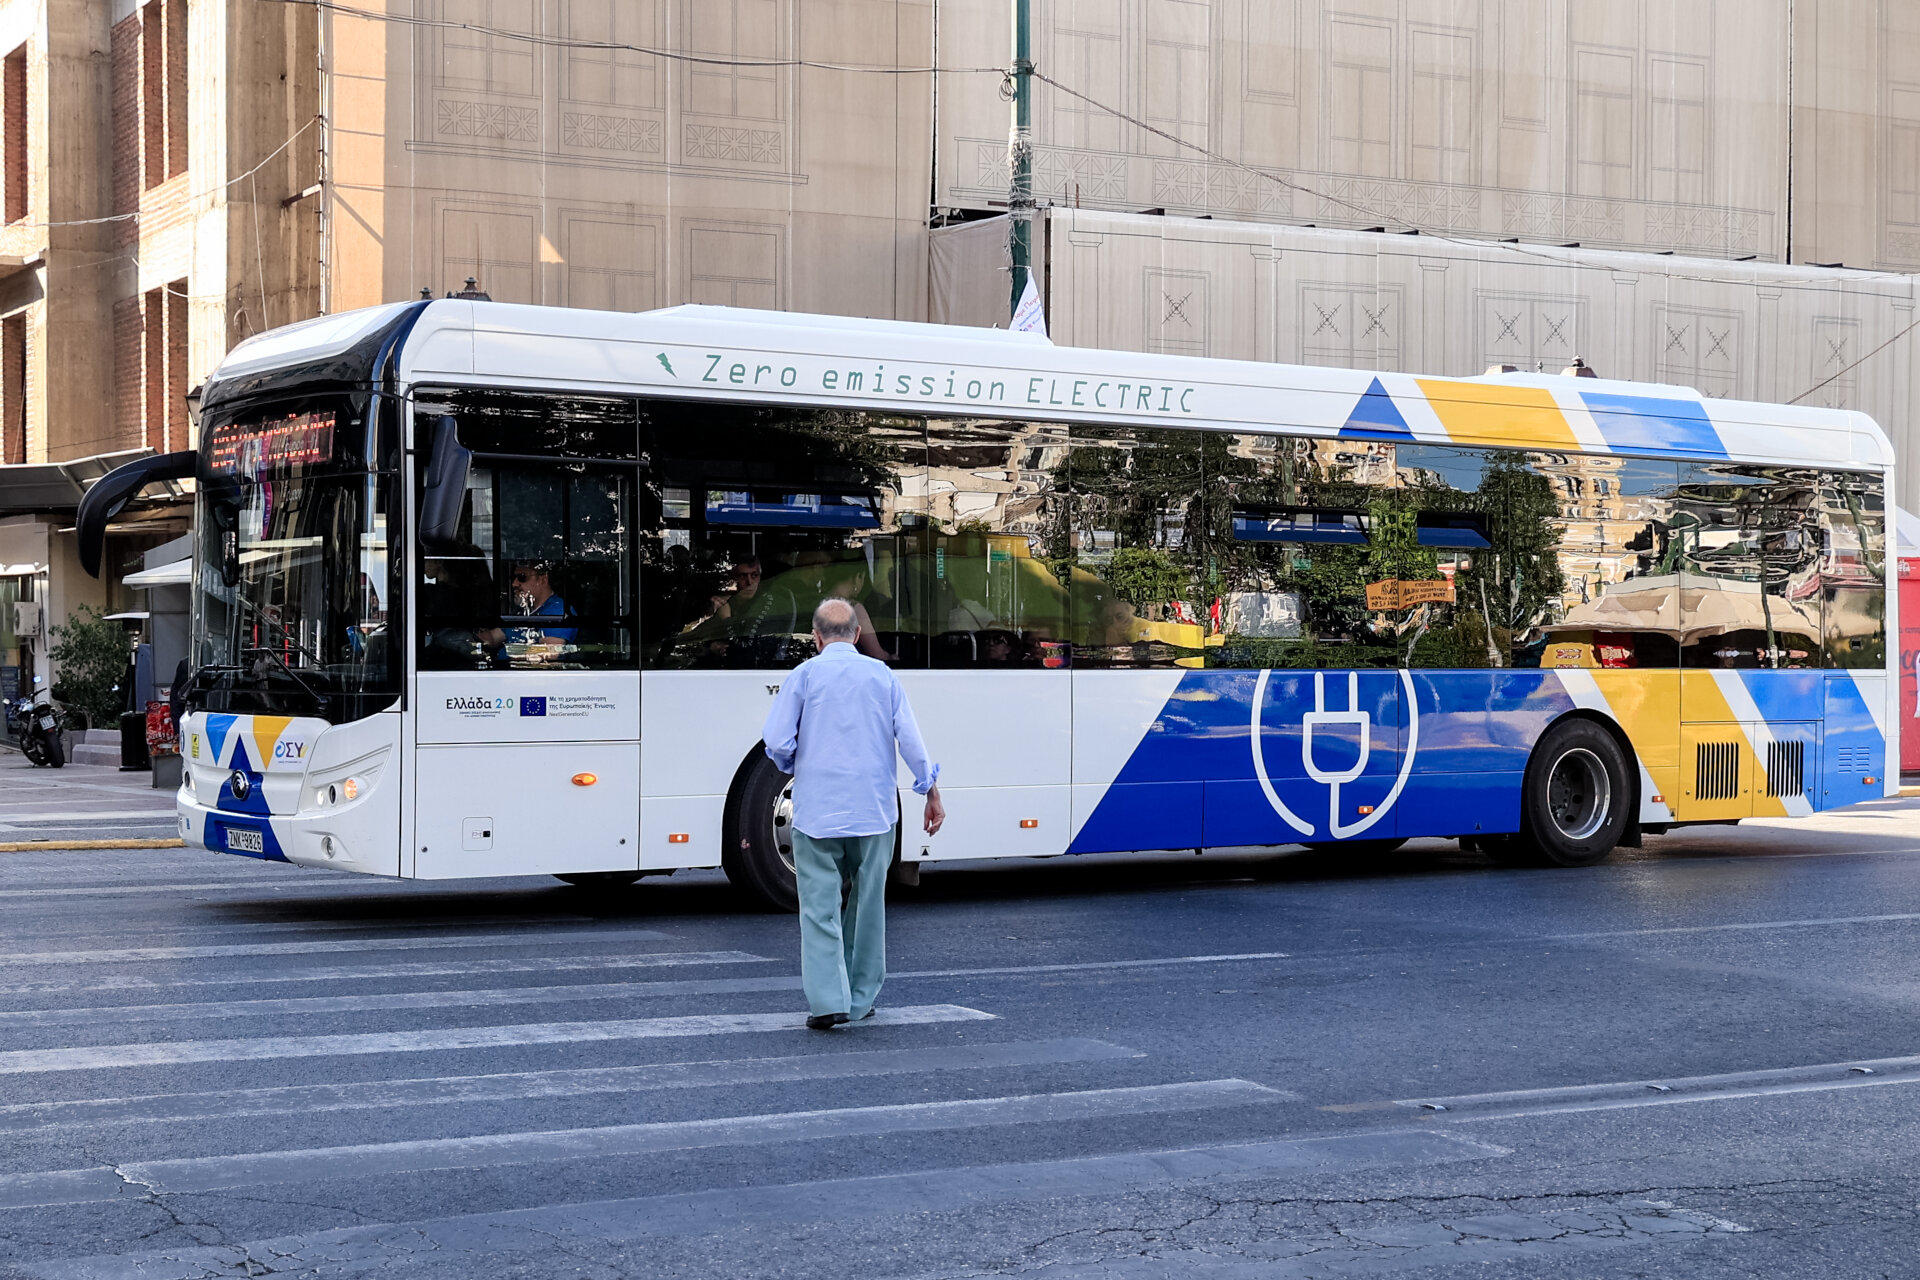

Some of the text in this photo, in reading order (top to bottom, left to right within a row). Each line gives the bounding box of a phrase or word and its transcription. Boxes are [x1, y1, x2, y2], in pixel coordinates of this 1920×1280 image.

[702, 354, 1194, 412] Zero emission ELECTRIC
[446, 697, 514, 709] Ελλάδα 2.0
